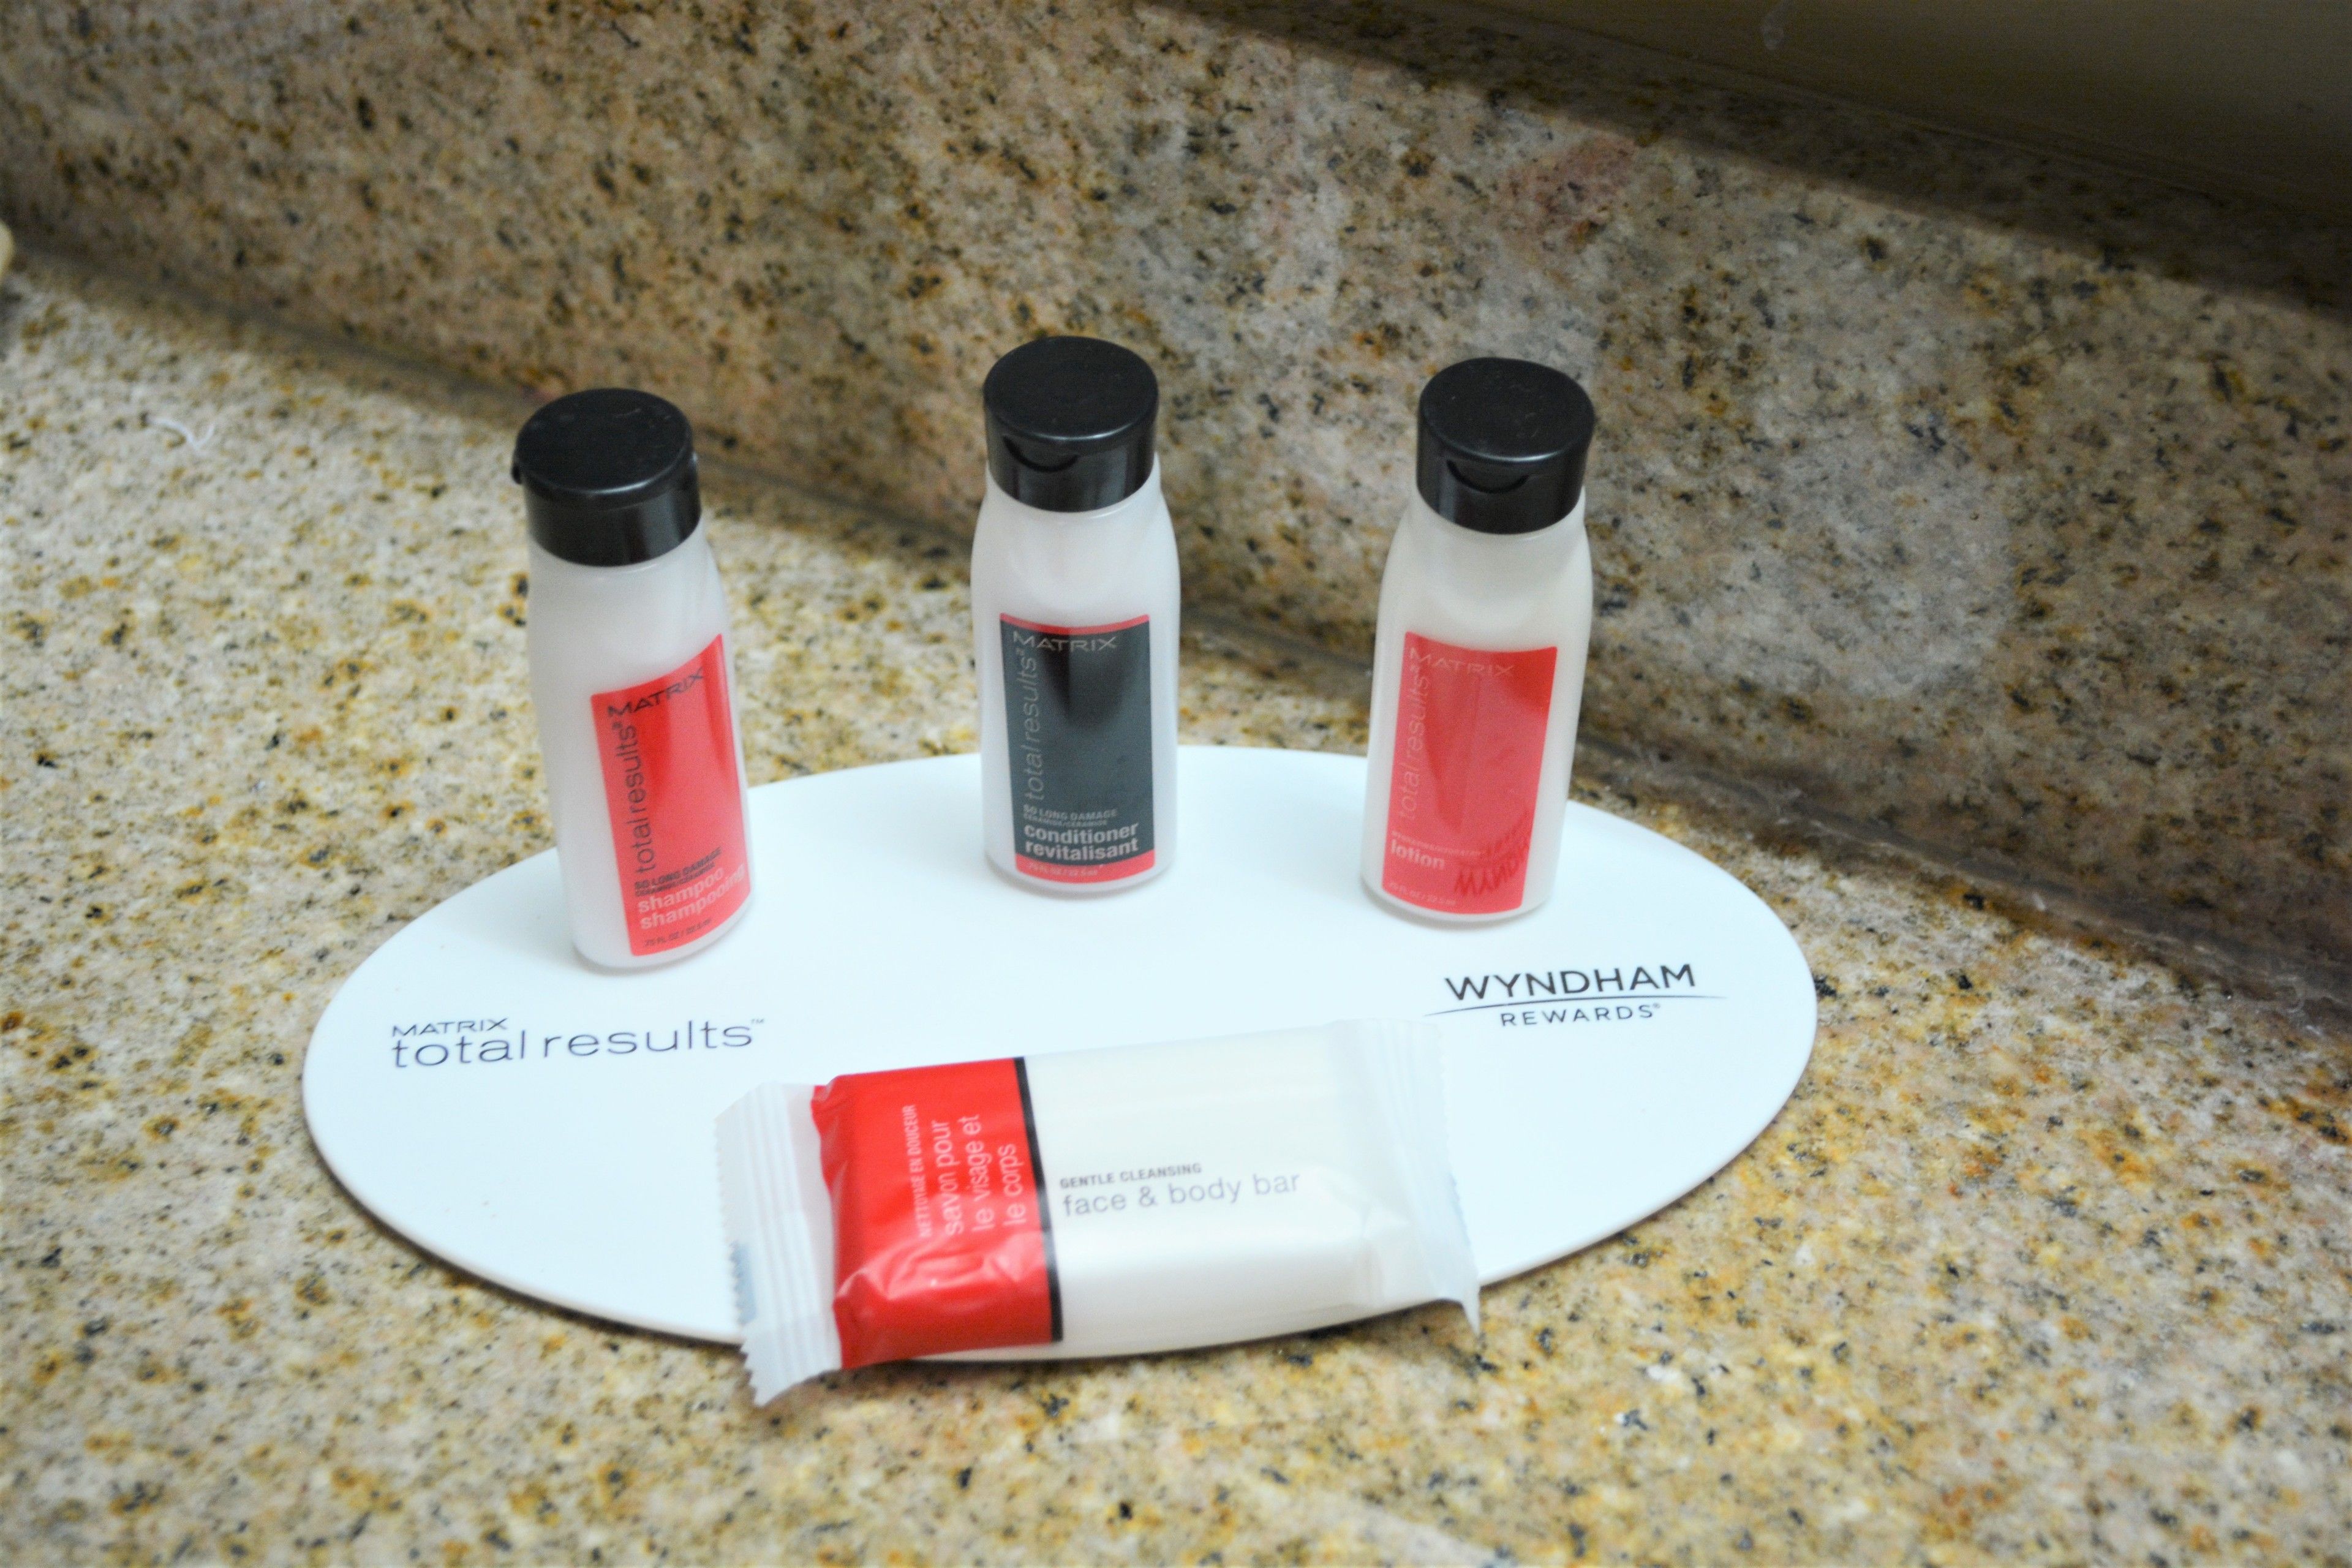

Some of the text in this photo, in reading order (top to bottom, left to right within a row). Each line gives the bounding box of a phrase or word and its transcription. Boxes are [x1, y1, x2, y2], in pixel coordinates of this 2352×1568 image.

[1012, 630, 1118, 652] MATRIX
[1409, 647, 1514, 677] MATRIX
[607, 666, 704, 716] MATRIX
[1070, 809, 1118, 821] DAMAGE
[1024, 823, 1139, 845] conditioner
[1025, 837, 1139, 861] revitalisant
[1390, 839, 1446, 870] lotion
[638, 867, 725, 913] shampoo
[1444, 963, 1696, 1001] WYNDHAM
[391, 1017, 508, 1037] MATRIX
[902, 1104, 922, 1156] DOUCEUR
[908, 1158, 924, 1173] EN
[930, 1120, 964, 1235] savon pour
[957, 1114, 996, 1232] le visage et
[1060, 1163, 1202, 1189] GENTLE CLEANSING
[997, 1144, 1027, 1226] le corps
[1062, 1172, 1300, 1217] face & body bar
